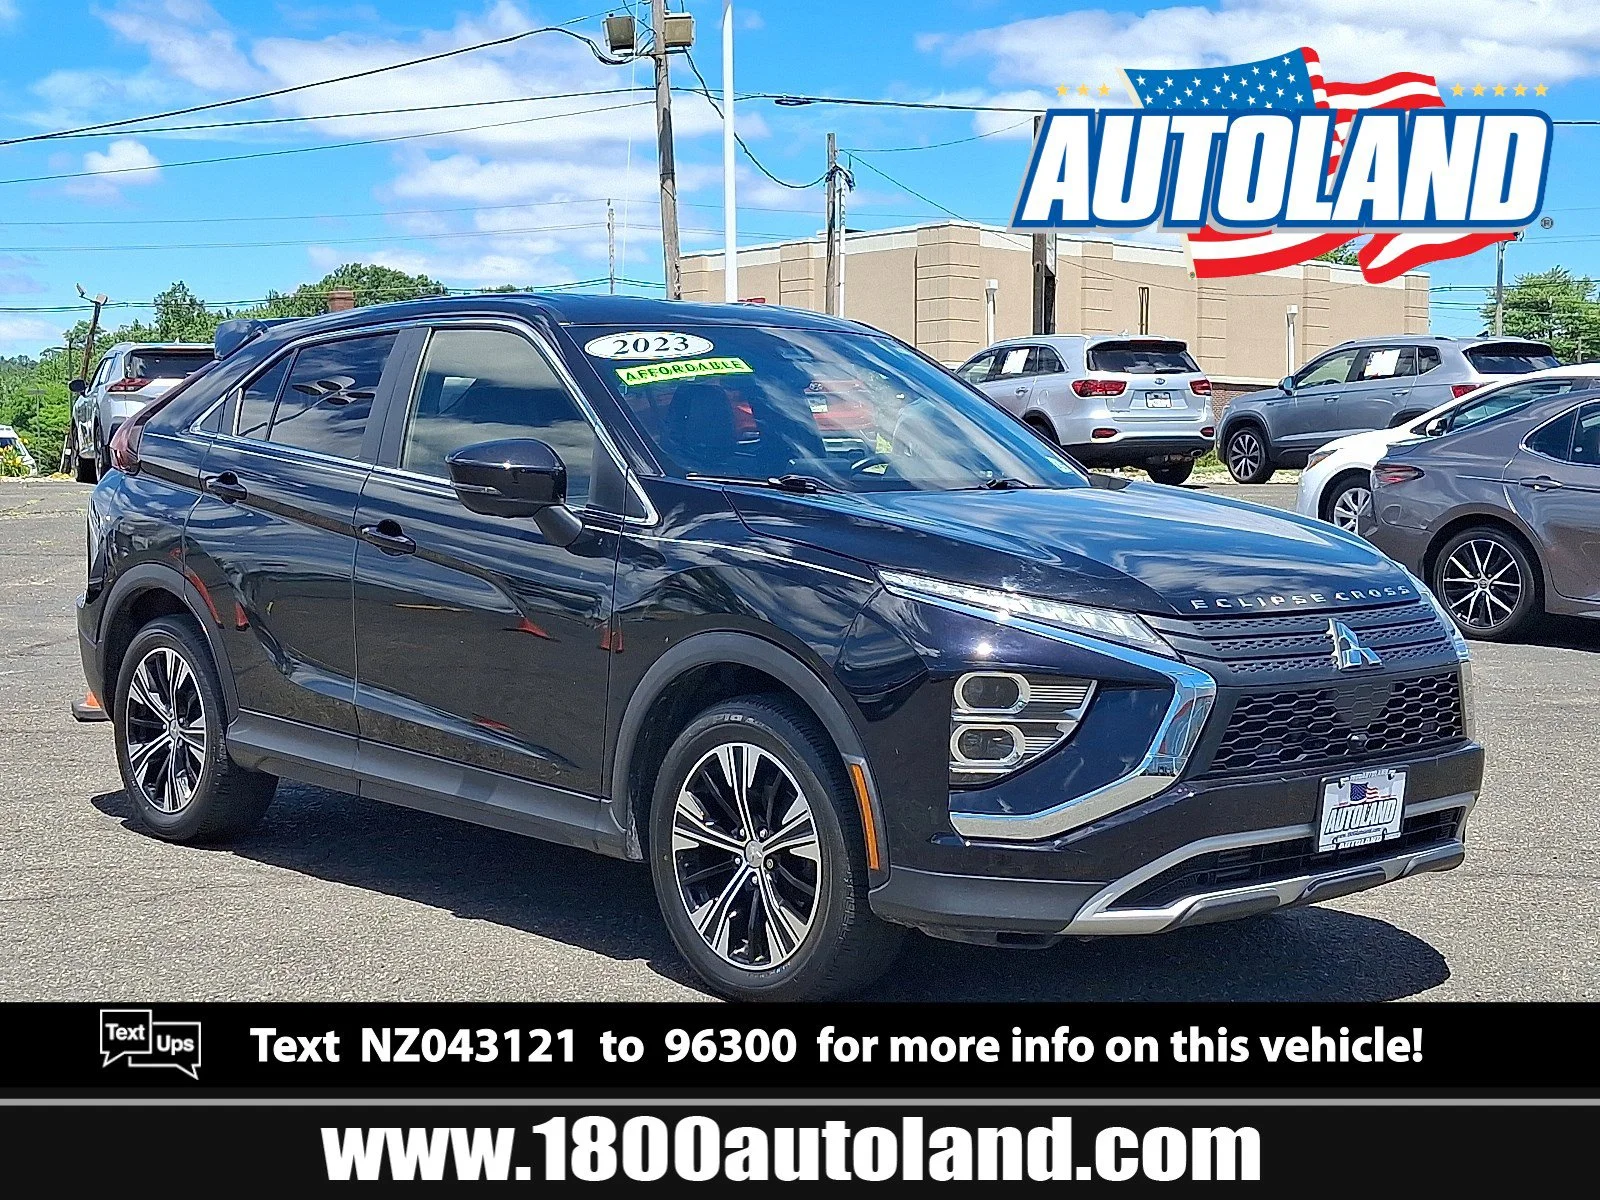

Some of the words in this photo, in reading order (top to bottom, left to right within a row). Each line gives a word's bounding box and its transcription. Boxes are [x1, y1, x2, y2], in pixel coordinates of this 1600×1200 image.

[613, 336, 689, 355] 2023
[626, 360, 742, 381] AFFORDABLE
[1191, 593, 1326, 610] ECLIPSE
[1335, 585, 1411, 601] CROSS
[1324, 799, 1397, 835] AUTOLAND
